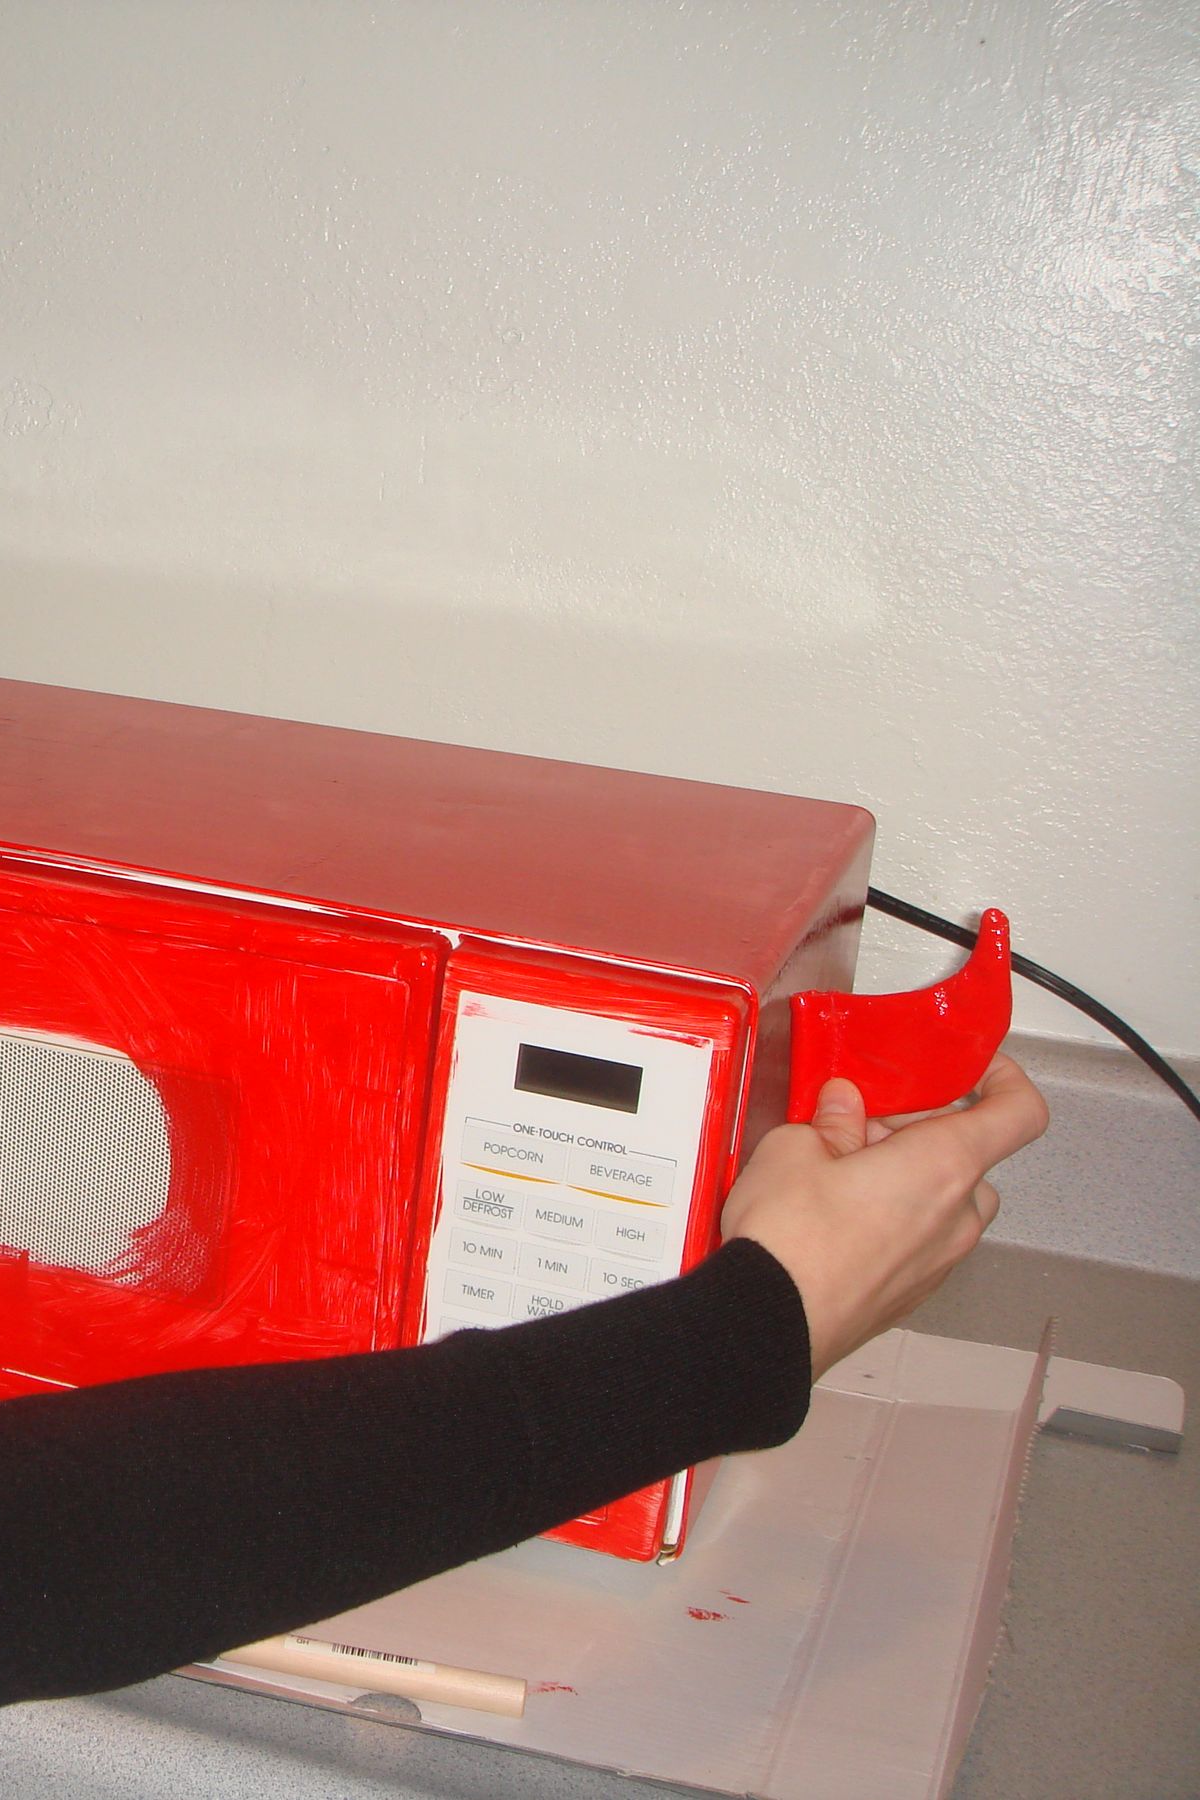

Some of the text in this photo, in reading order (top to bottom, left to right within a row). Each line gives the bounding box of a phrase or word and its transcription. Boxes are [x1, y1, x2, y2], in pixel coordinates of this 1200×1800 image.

[513, 1123, 628, 1155] ONE-TOUCH CONTROL
[483, 1142, 544, 1164] POPCORN
[589, 1164, 653, 1187] BEVERAGE
[475, 1188, 505, 1203] LOW
[463, 1200, 513, 1220] DEFROST
[535, 1209, 584, 1229] MEDIUM
[616, 1226, 645, 1242] HIGH
[463, 1241, 503, 1260] 10 MIN
[537, 1257, 568, 1274] 1 MIN
[603, 1272, 644, 1290] 10 SEC
[462, 1284, 495, 1301] TIMER
[531, 1295, 564, 1311] HOLD
